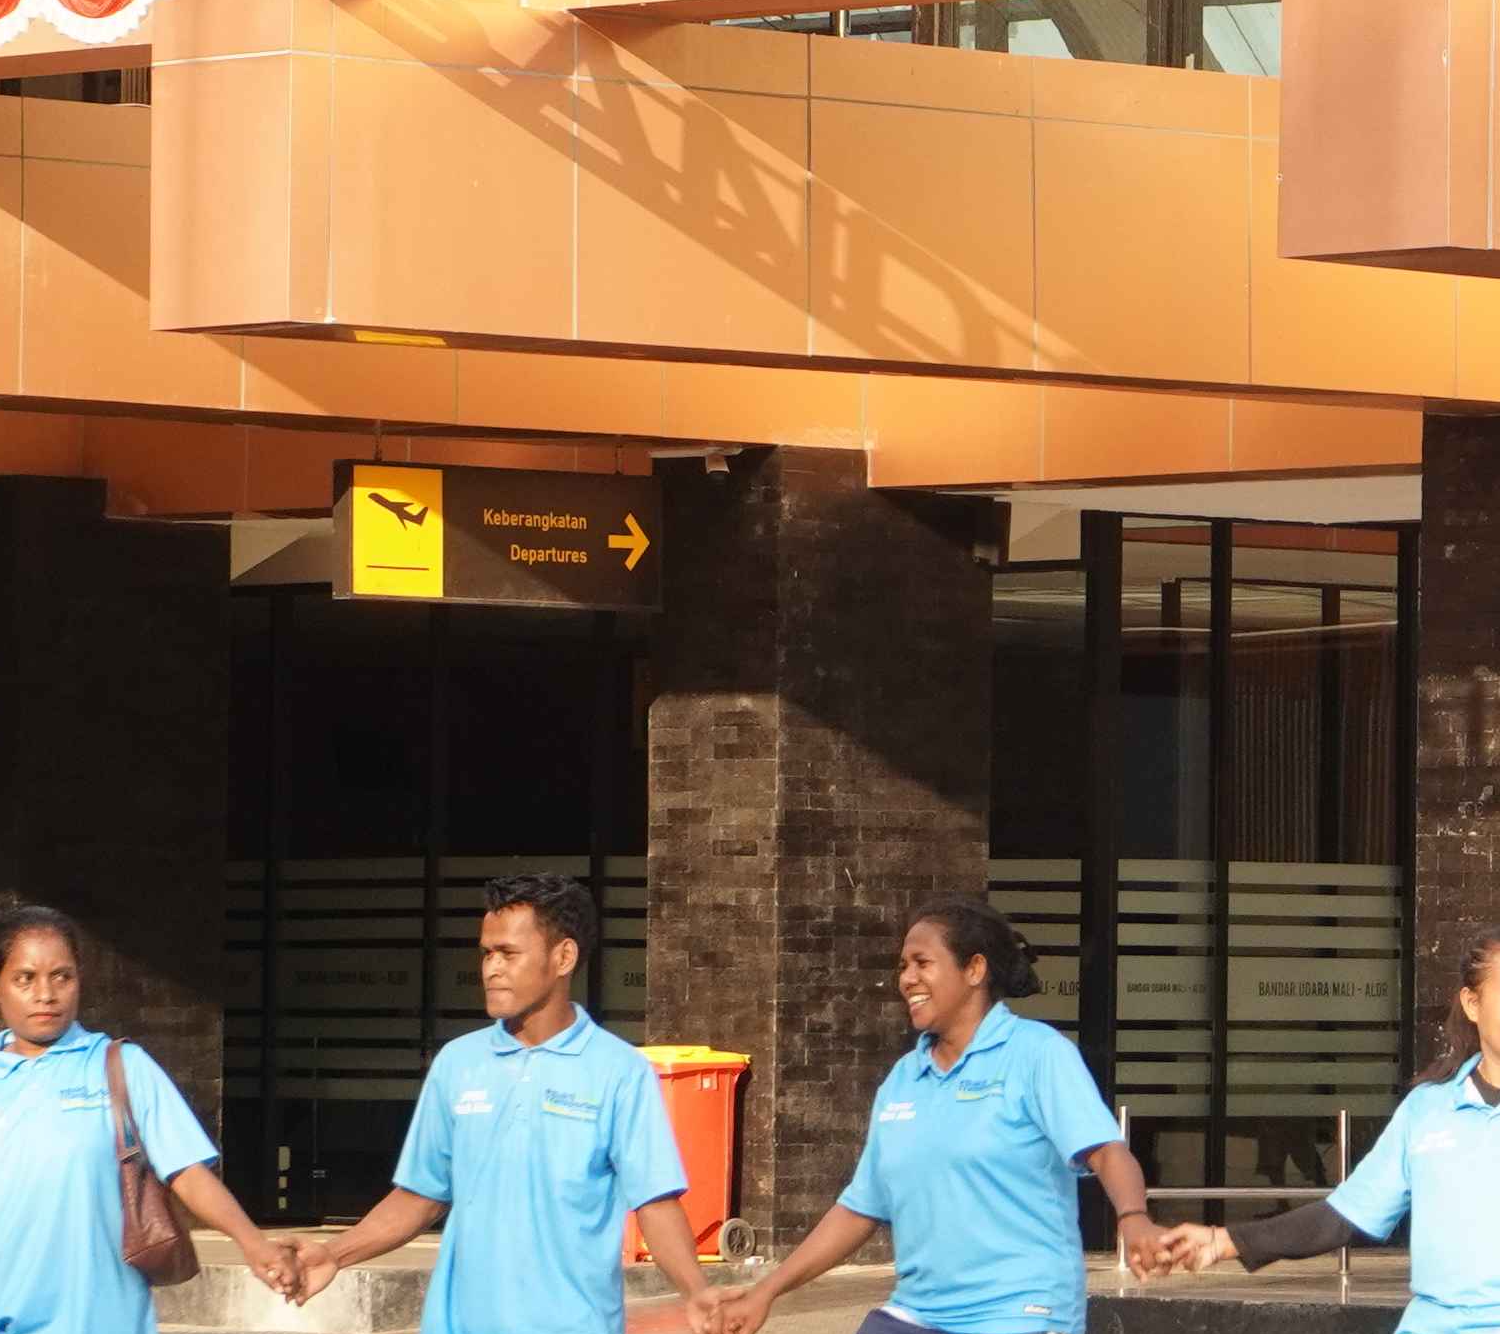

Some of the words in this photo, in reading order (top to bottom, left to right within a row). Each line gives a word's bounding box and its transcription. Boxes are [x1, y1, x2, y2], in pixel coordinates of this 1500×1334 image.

[482, 508, 587, 531] Keberangkatan
[510, 544, 587, 565] Departures
[1258, 981, 1297, 997] BANDAR
[1298, 981, 1330, 997] UDARA
[1331, 981, 1356, 997] MALI
